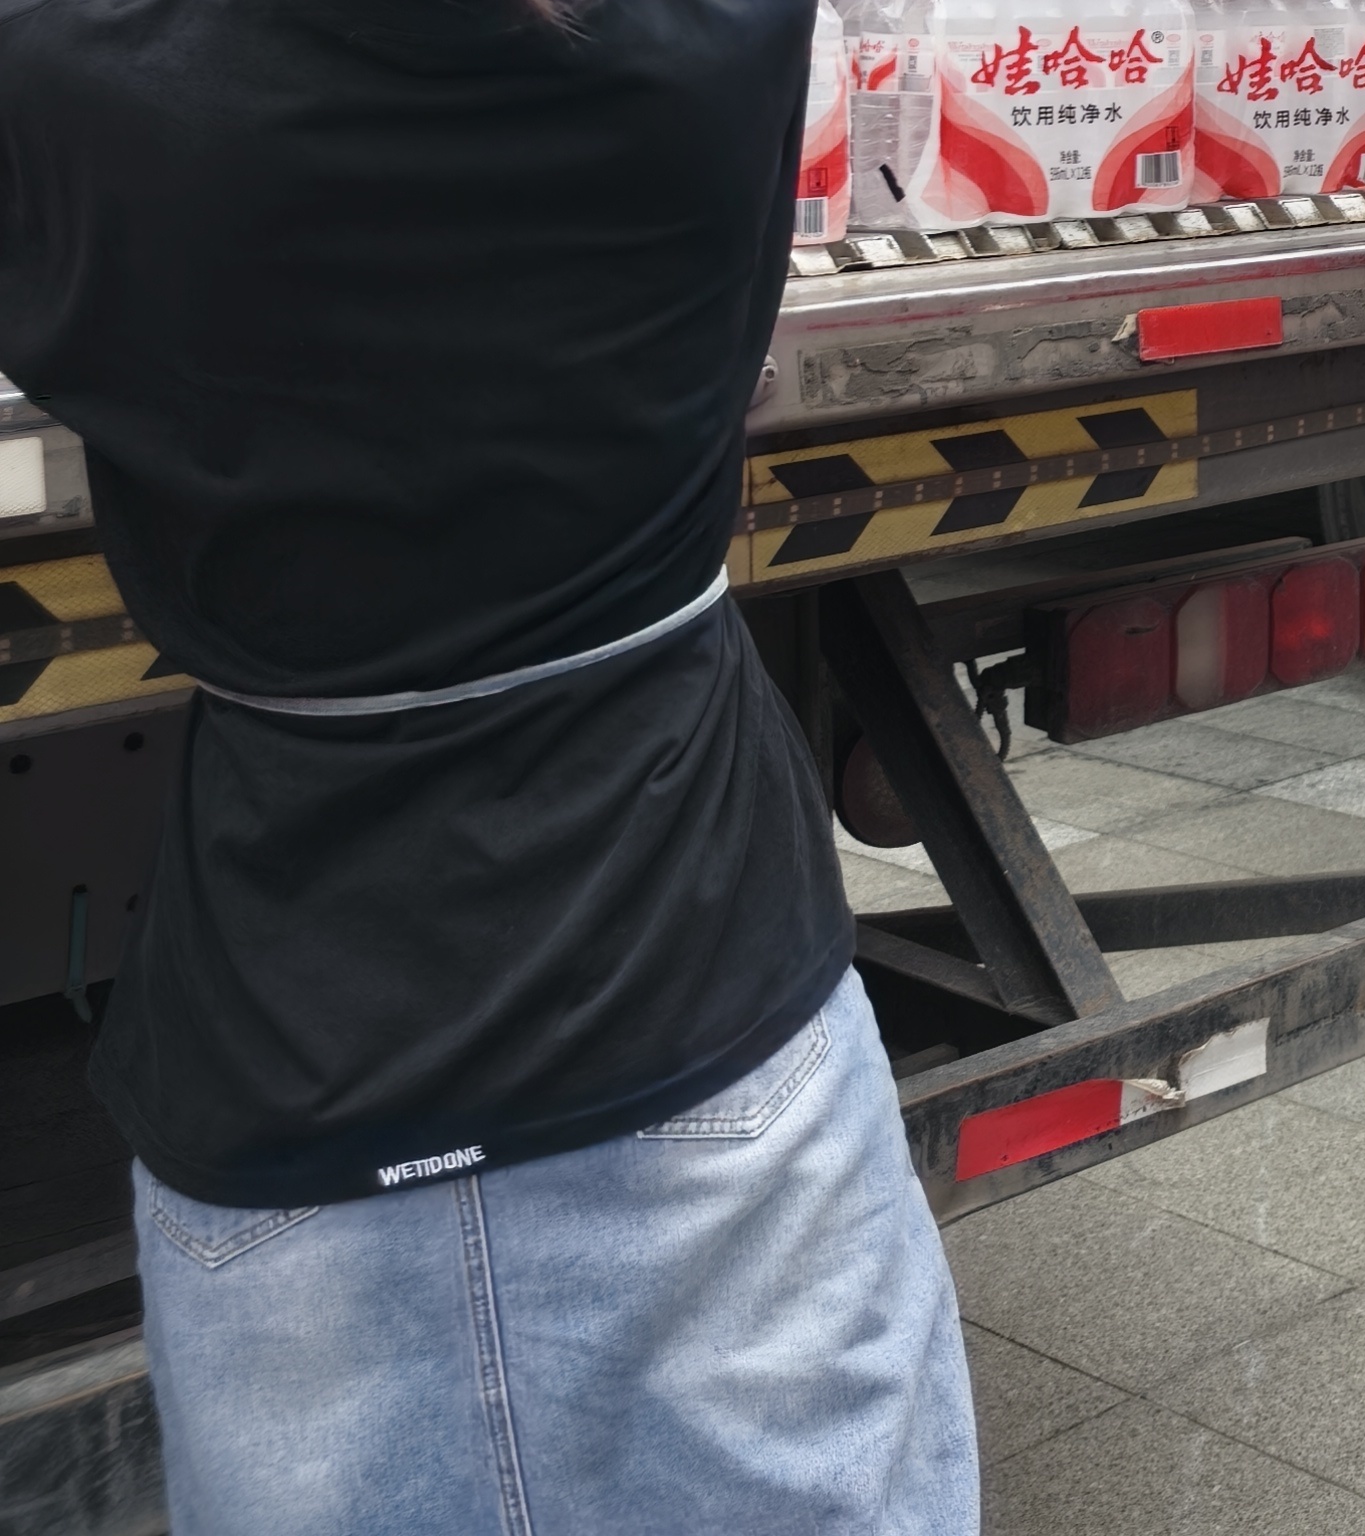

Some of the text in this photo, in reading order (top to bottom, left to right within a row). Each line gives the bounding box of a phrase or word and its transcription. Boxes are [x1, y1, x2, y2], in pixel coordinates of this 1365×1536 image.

[970, 25, 1164, 95] 娃哈哈
[1011, 102, 1123, 127] 饮用纯净水
[1253, 107, 1350, 130] 饮用纯净水
